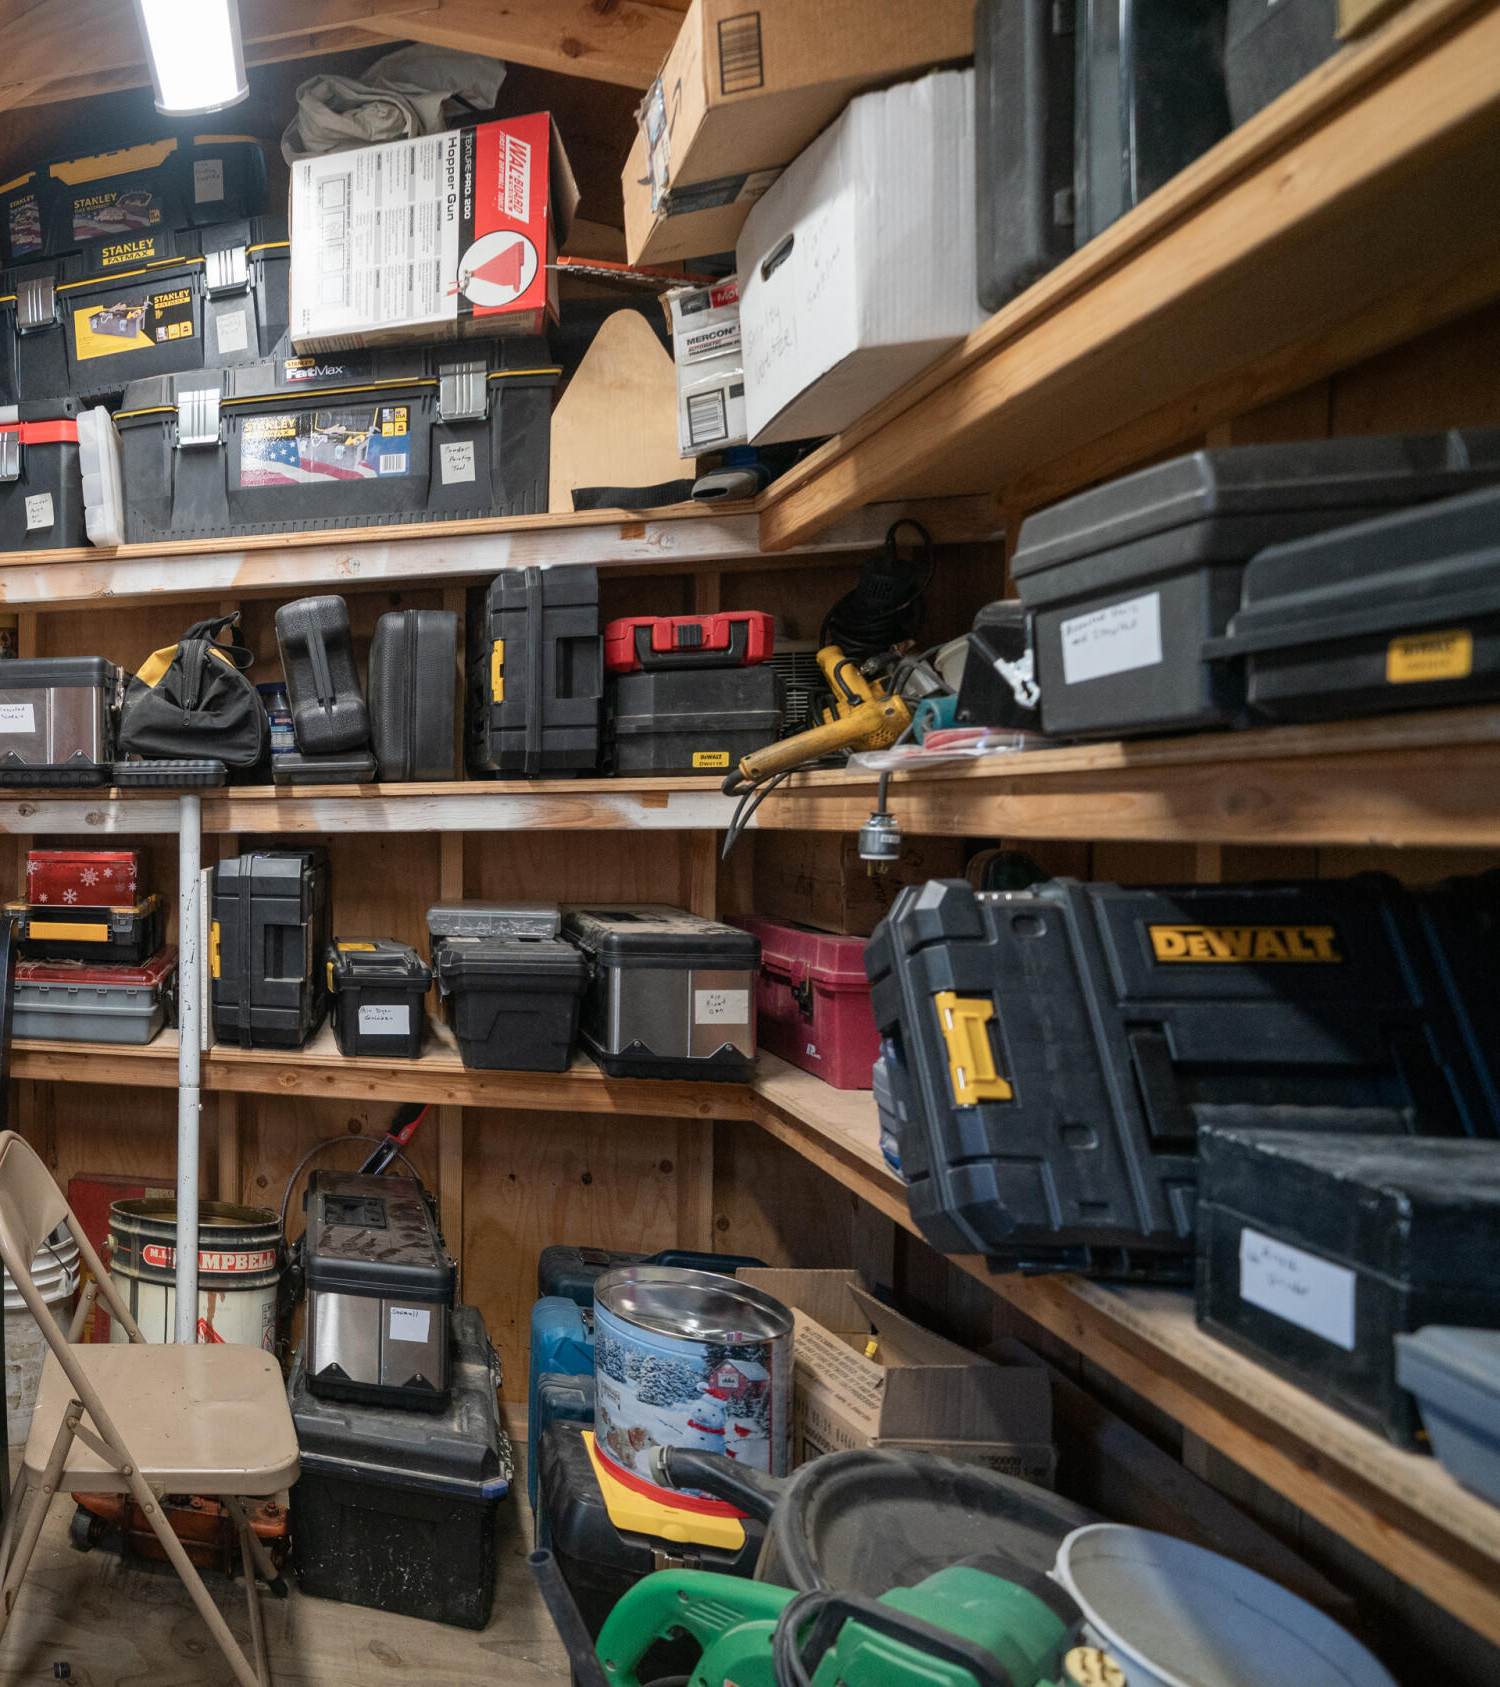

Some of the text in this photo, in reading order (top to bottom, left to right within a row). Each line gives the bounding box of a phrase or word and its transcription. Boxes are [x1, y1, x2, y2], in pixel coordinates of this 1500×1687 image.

[445, 136, 458, 221] Hopper Gun
[10, 194, 35, 208] STANLEY
[74, 192, 117, 209] STANLEY
[102, 238, 154, 258] STANLEY
[154, 289, 190, 304] STANLEY
[285, 365, 343, 379] FatMax
[201, 1252, 274, 1270] MPBELL
